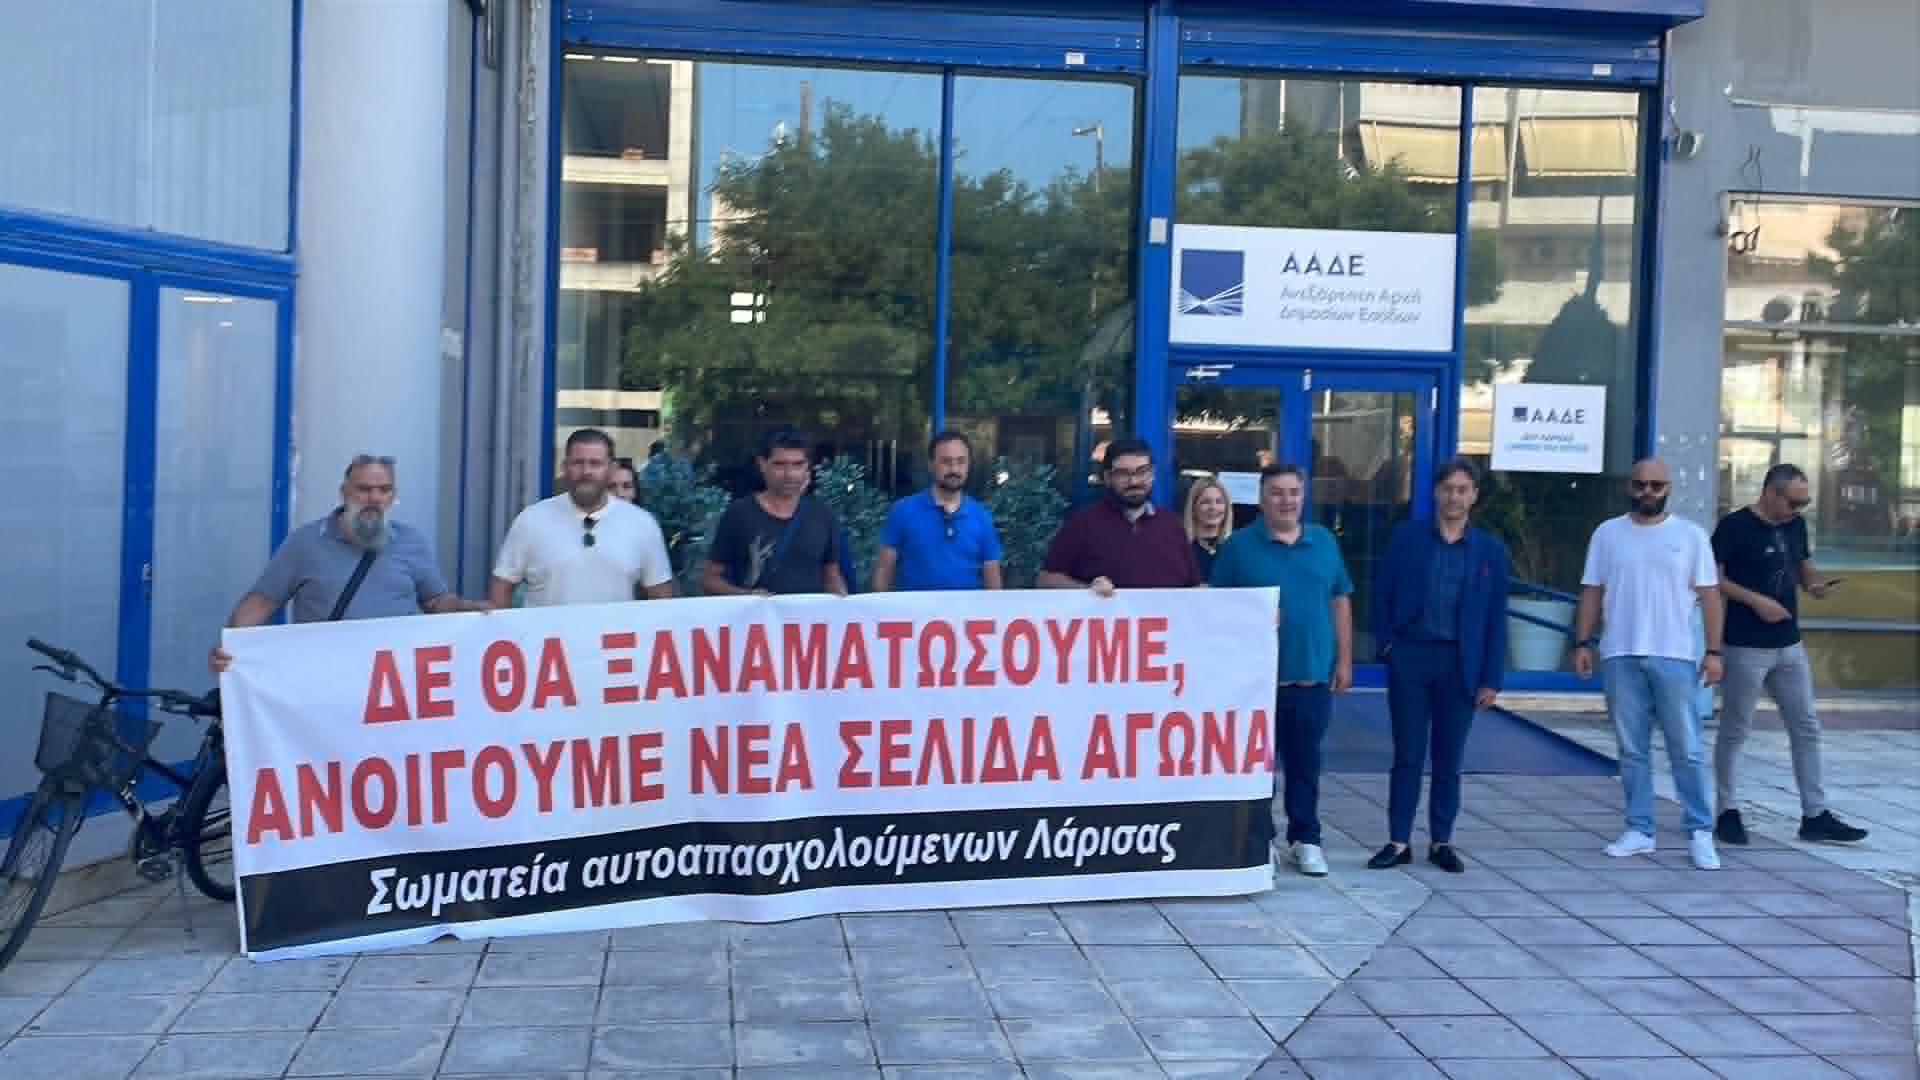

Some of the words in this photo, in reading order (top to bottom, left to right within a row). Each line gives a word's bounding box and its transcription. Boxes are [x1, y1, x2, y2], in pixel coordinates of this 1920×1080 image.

[1281, 252, 1365, 276] ΑΑΔΕ
[1531, 408, 1584, 424] ΑΑΔΕ
[364, 646, 455, 723] ΔΕ
[480, 638, 578, 712] ΘΑ
[601, 616, 1186, 704] ΞΑΝΑΜΑΤΩΣΟΥΜΕ,
[247, 733, 665, 845] ΑΝΟΙΓΟΥΜΕ
[689, 723, 813, 795] ΝΕΑ
[838, 716, 1061, 789] ΣΕΛΙΔΑ
[1082, 709, 1274, 780] ΑΓΩΝΑ
[366, 852, 568, 917] Σωματεία
[582, 824, 1021, 886] αυτοαπασχολούμενων
[1024, 818, 1181, 866] Λάρισας
